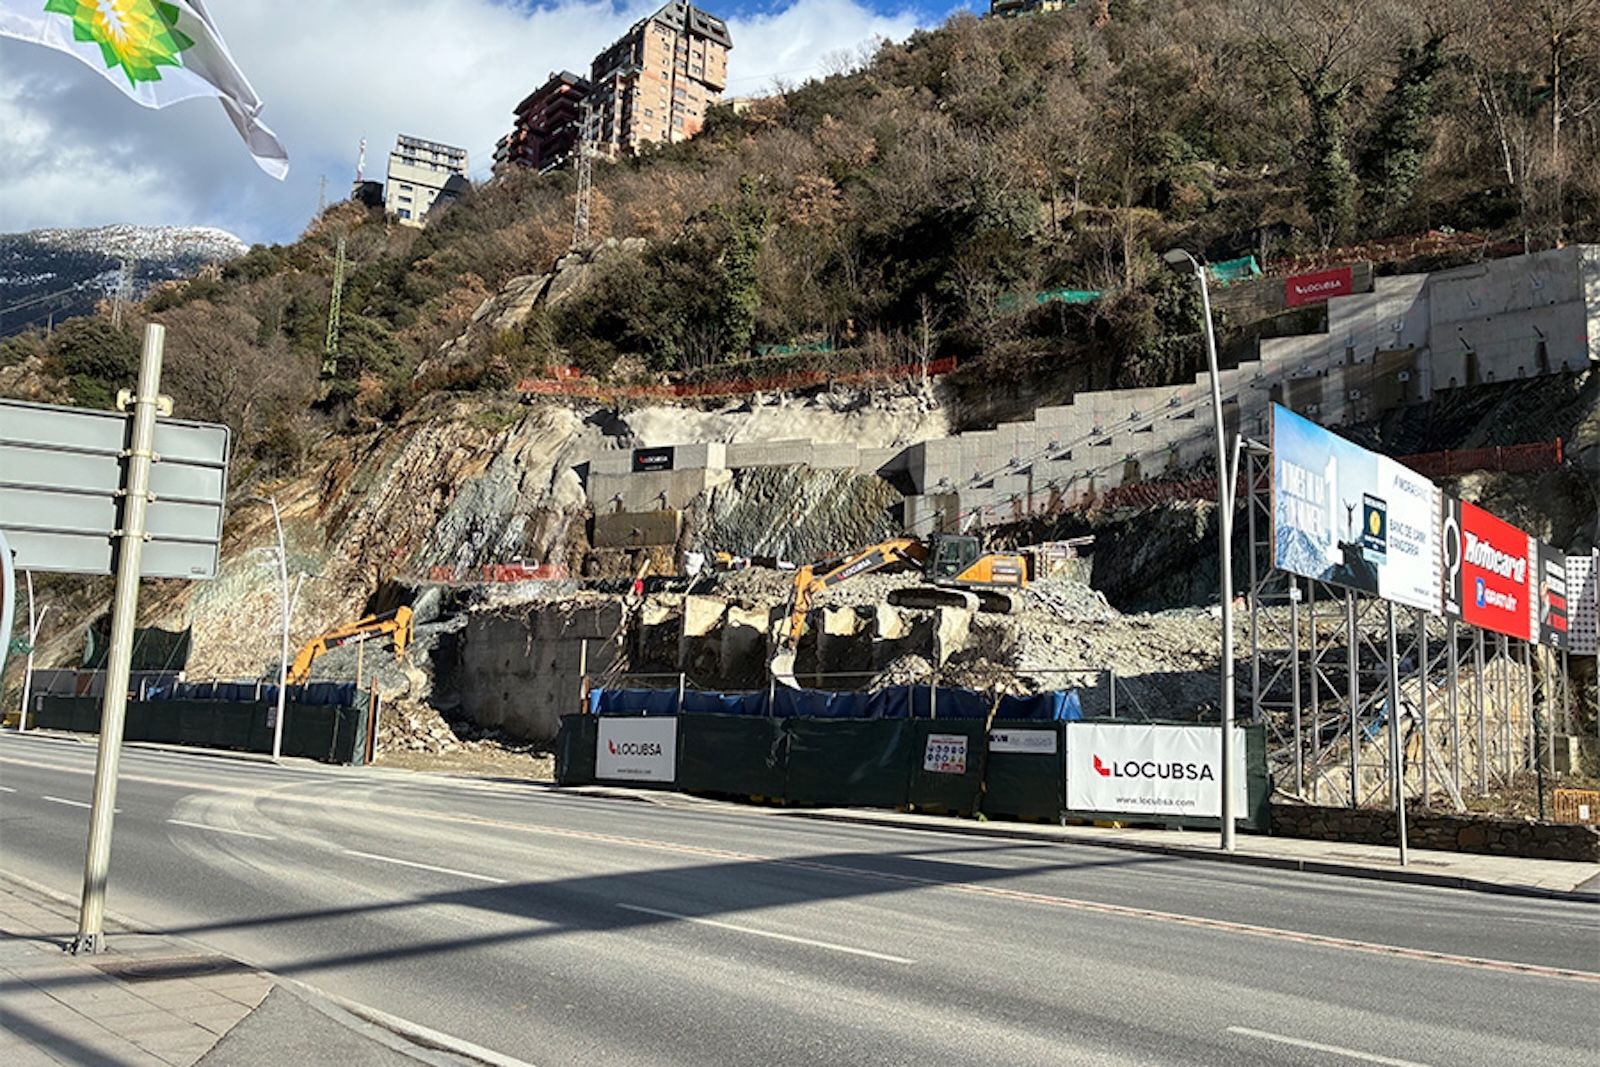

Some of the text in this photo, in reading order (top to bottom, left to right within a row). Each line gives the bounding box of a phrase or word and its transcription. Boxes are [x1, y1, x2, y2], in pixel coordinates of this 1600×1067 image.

[617, 742, 662, 756] LOCUBSA
[1113, 761, 1215, 781] LOCUBSA
[1115, 796, 1196, 807] www.locubsa.com
